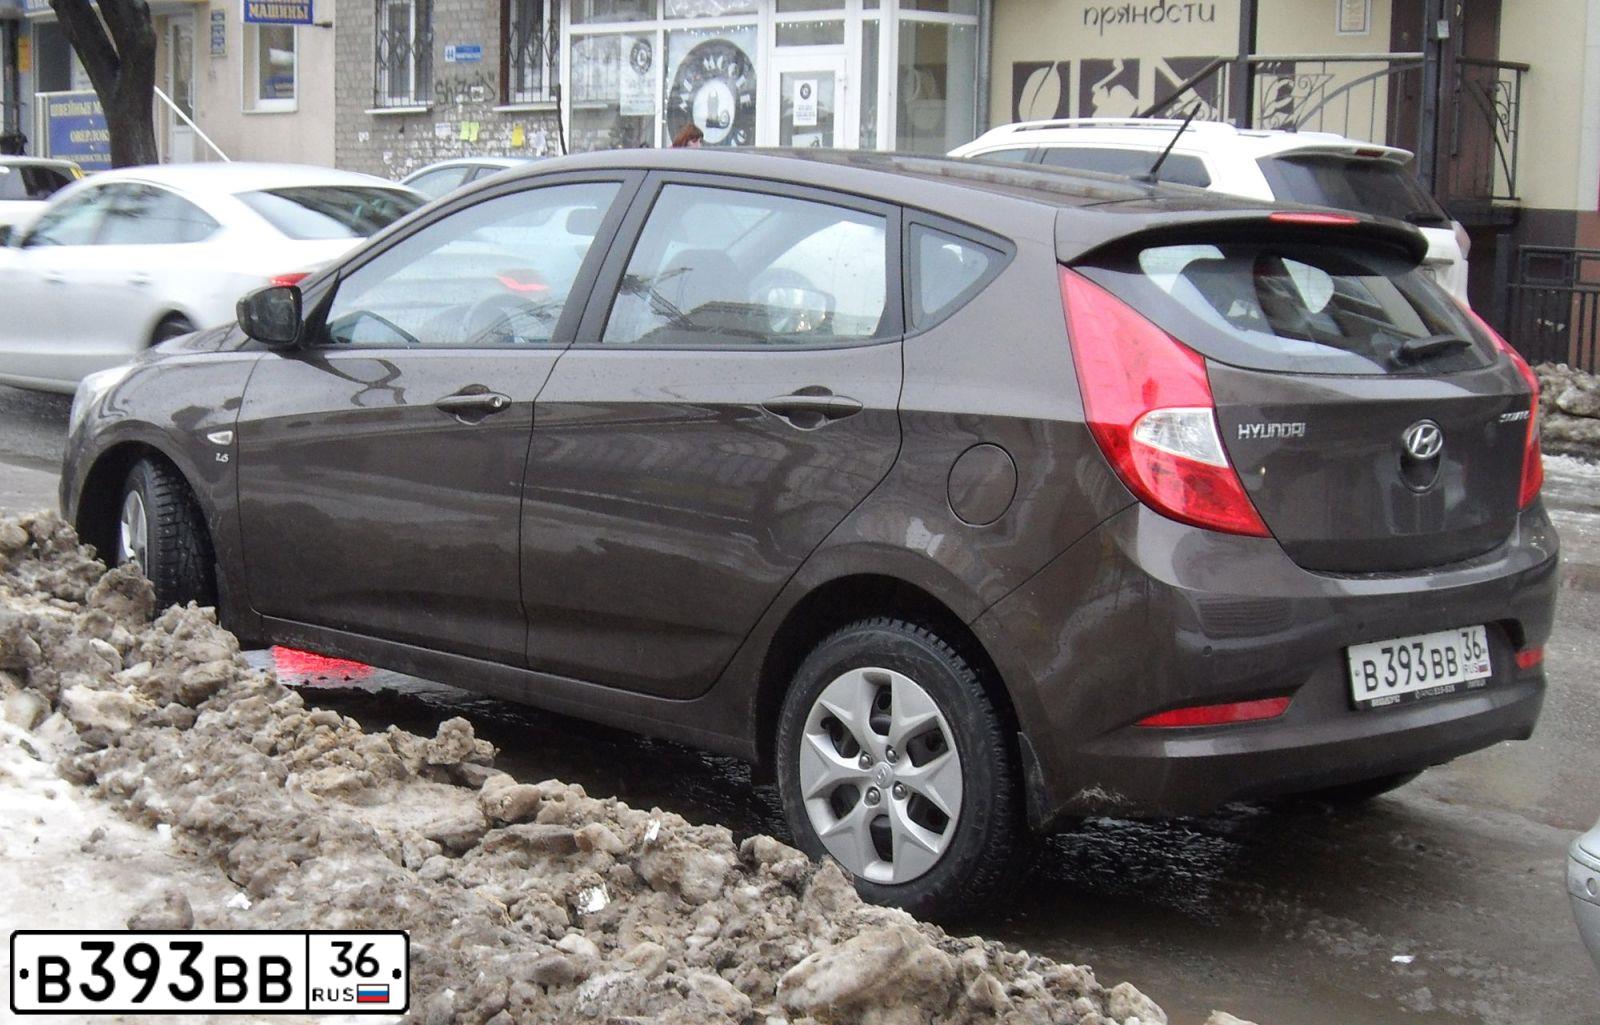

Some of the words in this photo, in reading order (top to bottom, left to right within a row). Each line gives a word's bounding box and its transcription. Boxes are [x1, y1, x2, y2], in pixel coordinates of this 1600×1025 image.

[249, 3, 309, 19] МАШИНЫ
[1083, 3, 1216, 36] пряности
[1238, 421, 1306, 440] HYUNDAI
[1461, 630, 1482, 661] 36
